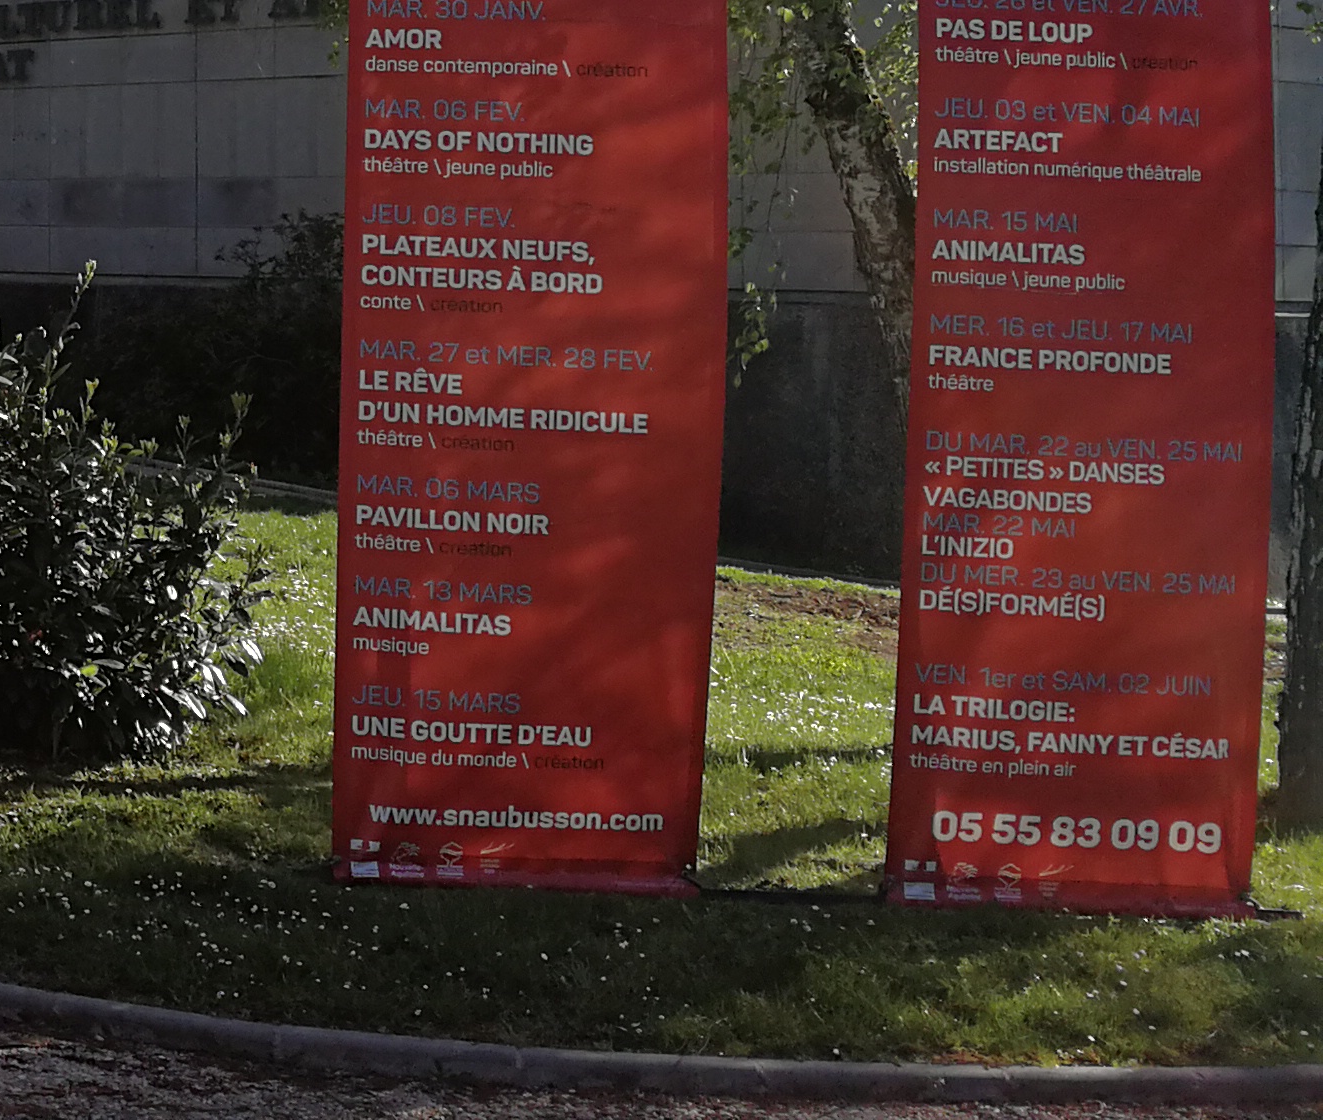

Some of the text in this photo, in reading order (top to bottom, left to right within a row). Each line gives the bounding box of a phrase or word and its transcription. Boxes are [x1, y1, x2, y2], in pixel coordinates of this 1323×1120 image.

[366, 29, 442, 49] AMOR
[936, 18, 1093, 43] PAS DE LOUP
[365, 57, 558, 77] danse contemporaine
[364, 128, 594, 156] DAYS OF NOTHING
[934, 129, 1063, 153] ARTEFACT
[933, 156, 1202, 182] installation numérique théâtrale
[362, 234, 595, 266] PLATEAUX NEUFS,
[928, 345, 1172, 375] FRANCE PROFONDE
[357, 474, 540, 504] MAR. 06 MARS
[923, 486, 1092, 514] VAGABONDES
[356, 504, 549, 535] PAVILLON NOIR
[921, 535, 1014, 560] L'INIZIO
[919, 587, 1105, 621] DÉ(S)FORMÉ(S)
[353, 606, 511, 636] ANIMALITAS
[353, 637, 430, 656] musique
[909, 753, 1076, 778] théâtre en plein air
[370, 805, 663, 832] www.snaubusson.com
[932, 810, 1222, 854] 05 55 83 09 09
